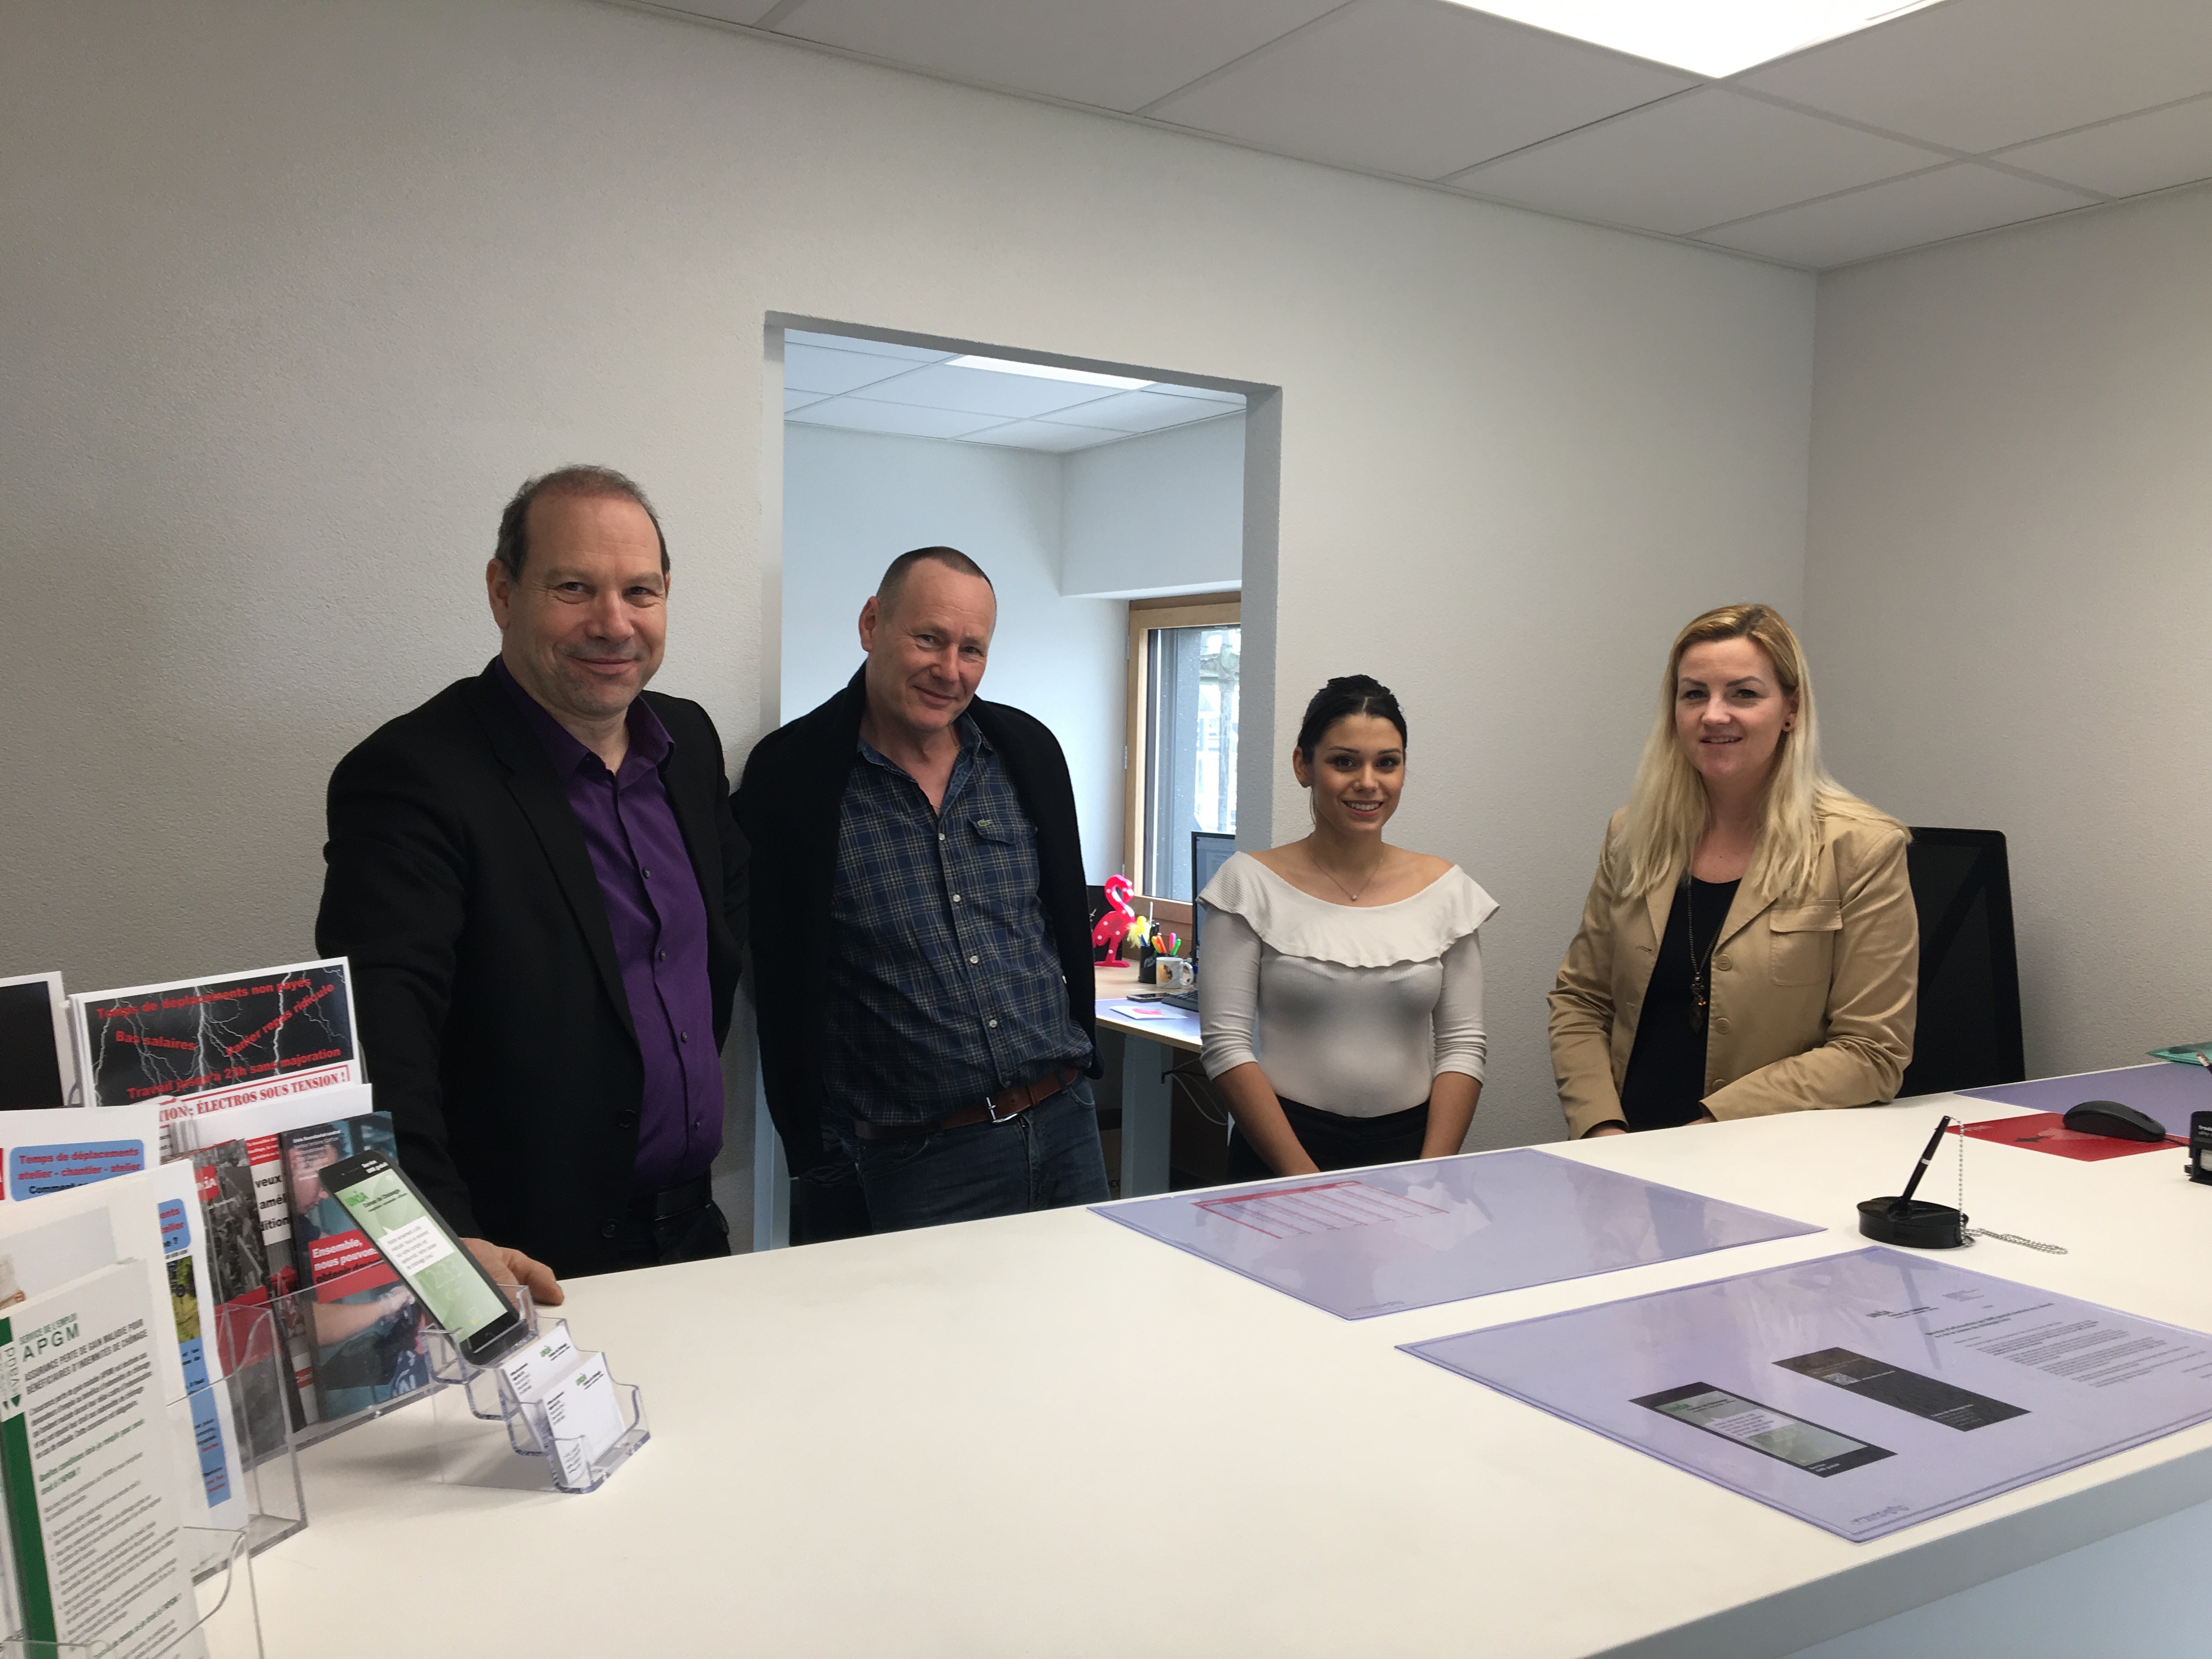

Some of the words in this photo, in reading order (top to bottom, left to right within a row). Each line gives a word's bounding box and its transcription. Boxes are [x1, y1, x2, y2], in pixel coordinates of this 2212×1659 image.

[97, 1006, 138, 1019] Temps
[142, 1001, 157, 1012] de
[251, 984, 274, 995] non
[115, 1030, 140, 1044] Bas
[144, 1036, 196, 1051] salaires
[280, 1048, 342, 1067] majoration
[259, 1084, 289, 1101] SOUS
[290, 1074, 338, 1093] TENSION
[22, 1323, 80, 1362] APGM
